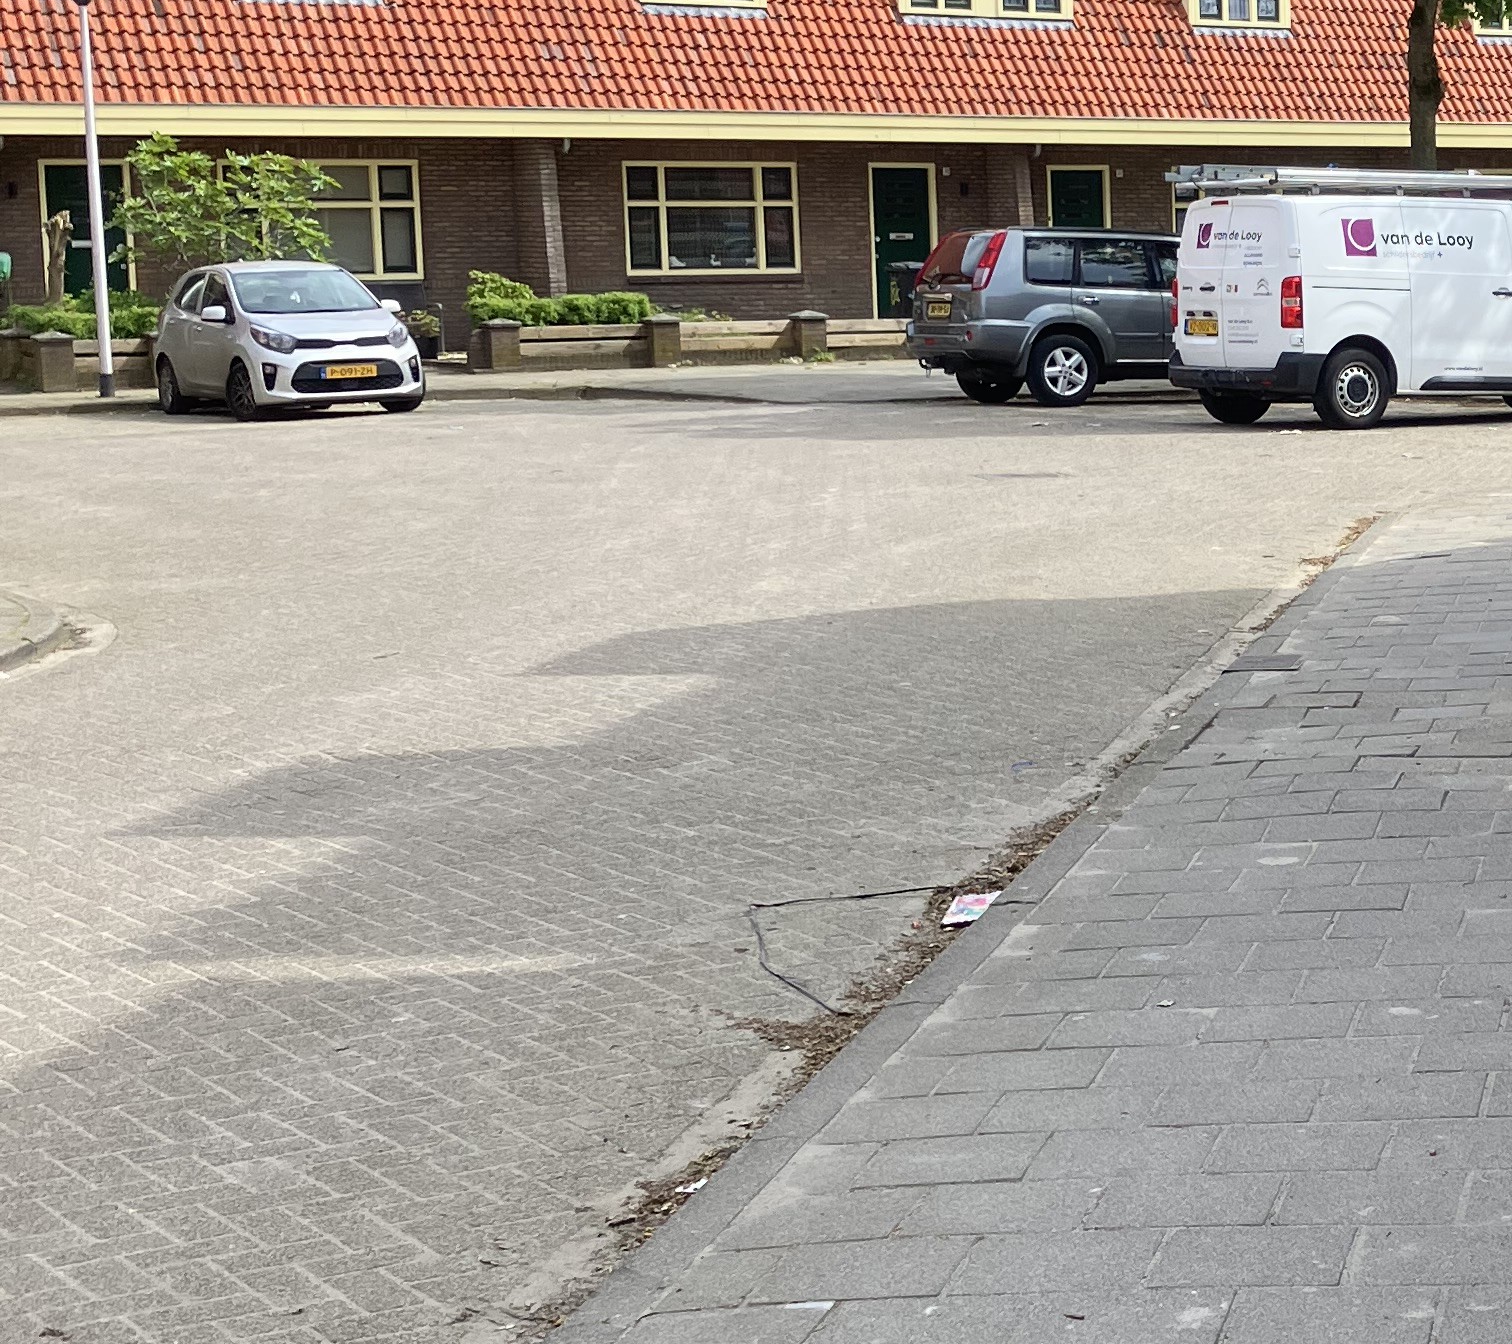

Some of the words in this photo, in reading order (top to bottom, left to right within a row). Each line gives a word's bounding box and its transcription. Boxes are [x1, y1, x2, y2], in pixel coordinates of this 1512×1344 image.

[1214, 232, 1228, 241] van
[1228, 230, 1239, 241] de
[1241, 230, 1263, 243] Looy
[1380, 233, 1410, 245] van
[1414, 231, 1433, 246] de
[1437, 232, 1474, 250] Looy
